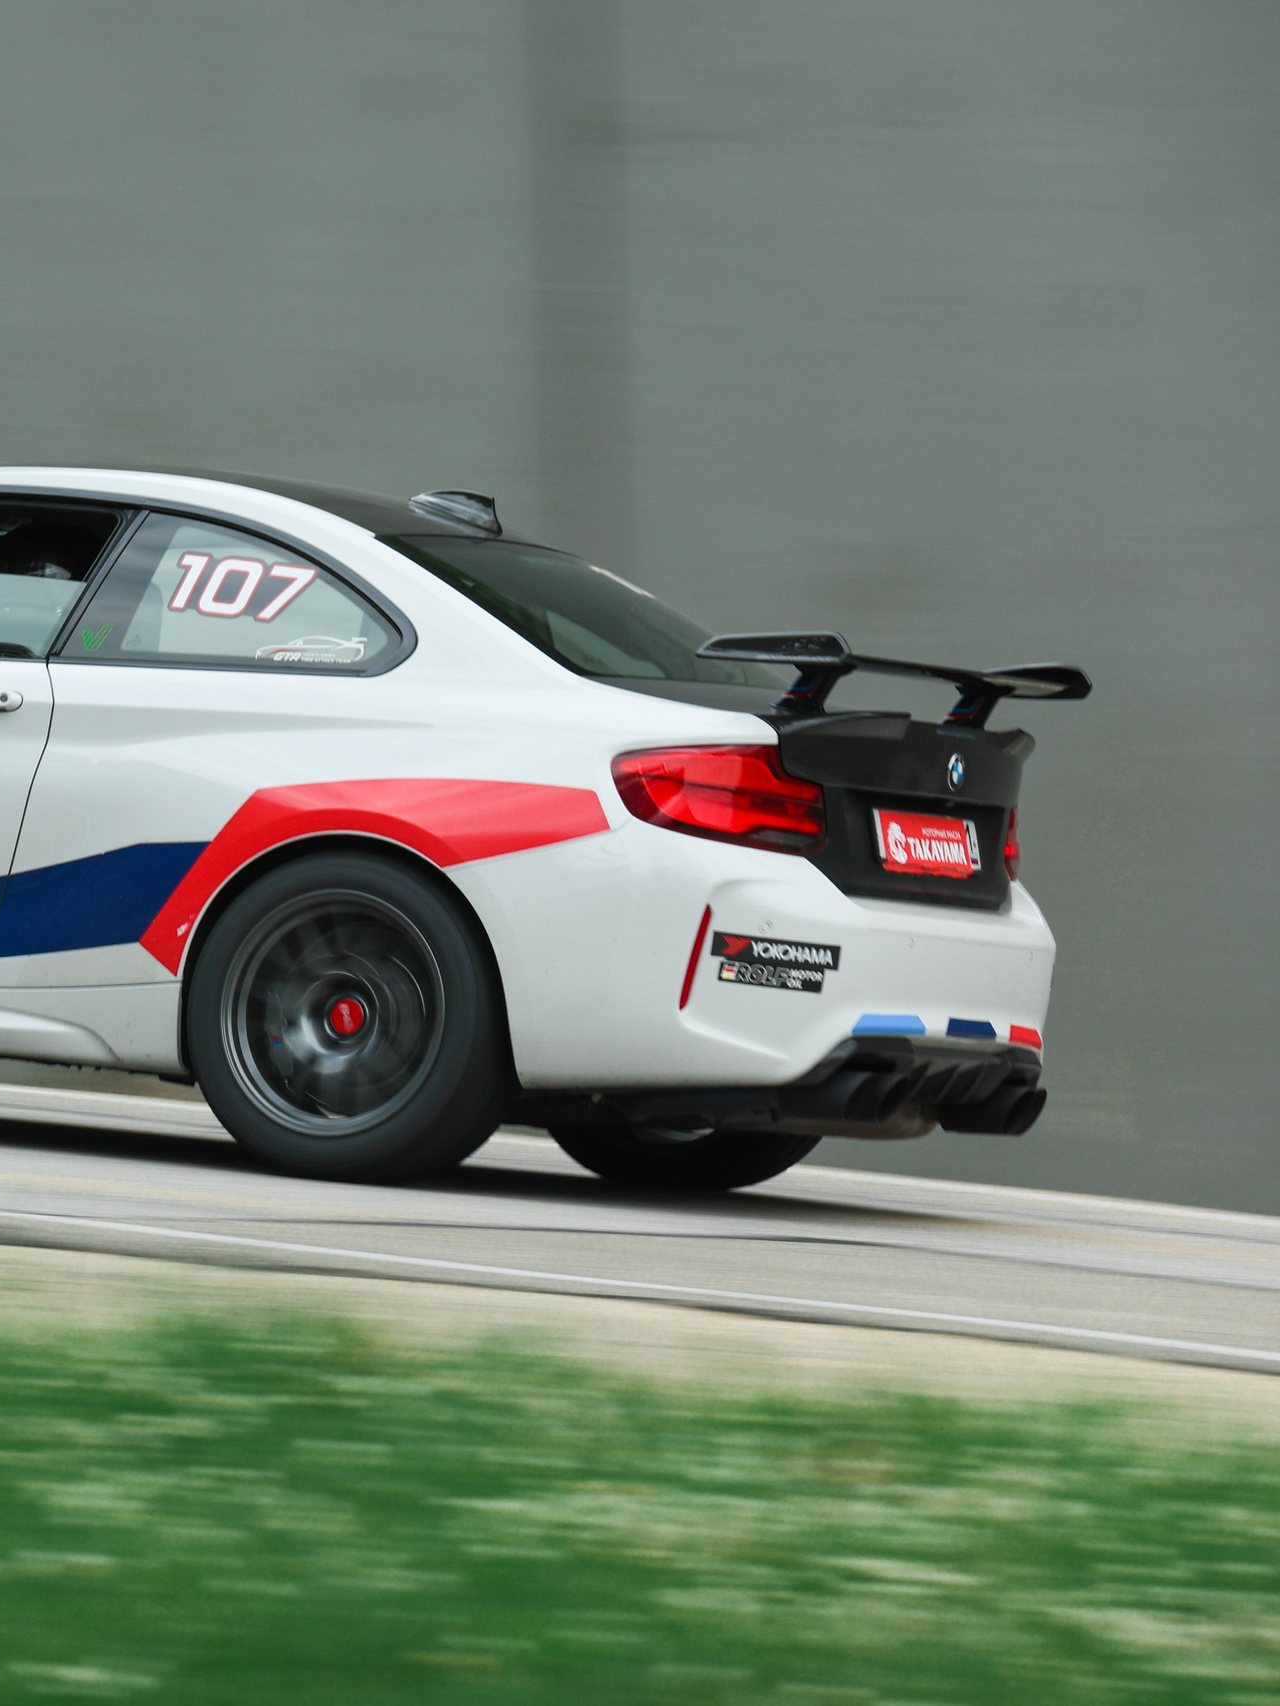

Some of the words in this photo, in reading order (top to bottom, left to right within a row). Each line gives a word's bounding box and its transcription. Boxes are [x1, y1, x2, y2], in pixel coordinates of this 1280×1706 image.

[169, 553, 318, 621] 107
[907, 837, 967, 865] TAKAYAMA
[750, 939, 834, 967] YOKOHAMA
[733, 960, 790, 987] ROLF
[789, 963, 824, 983] MOTOR
